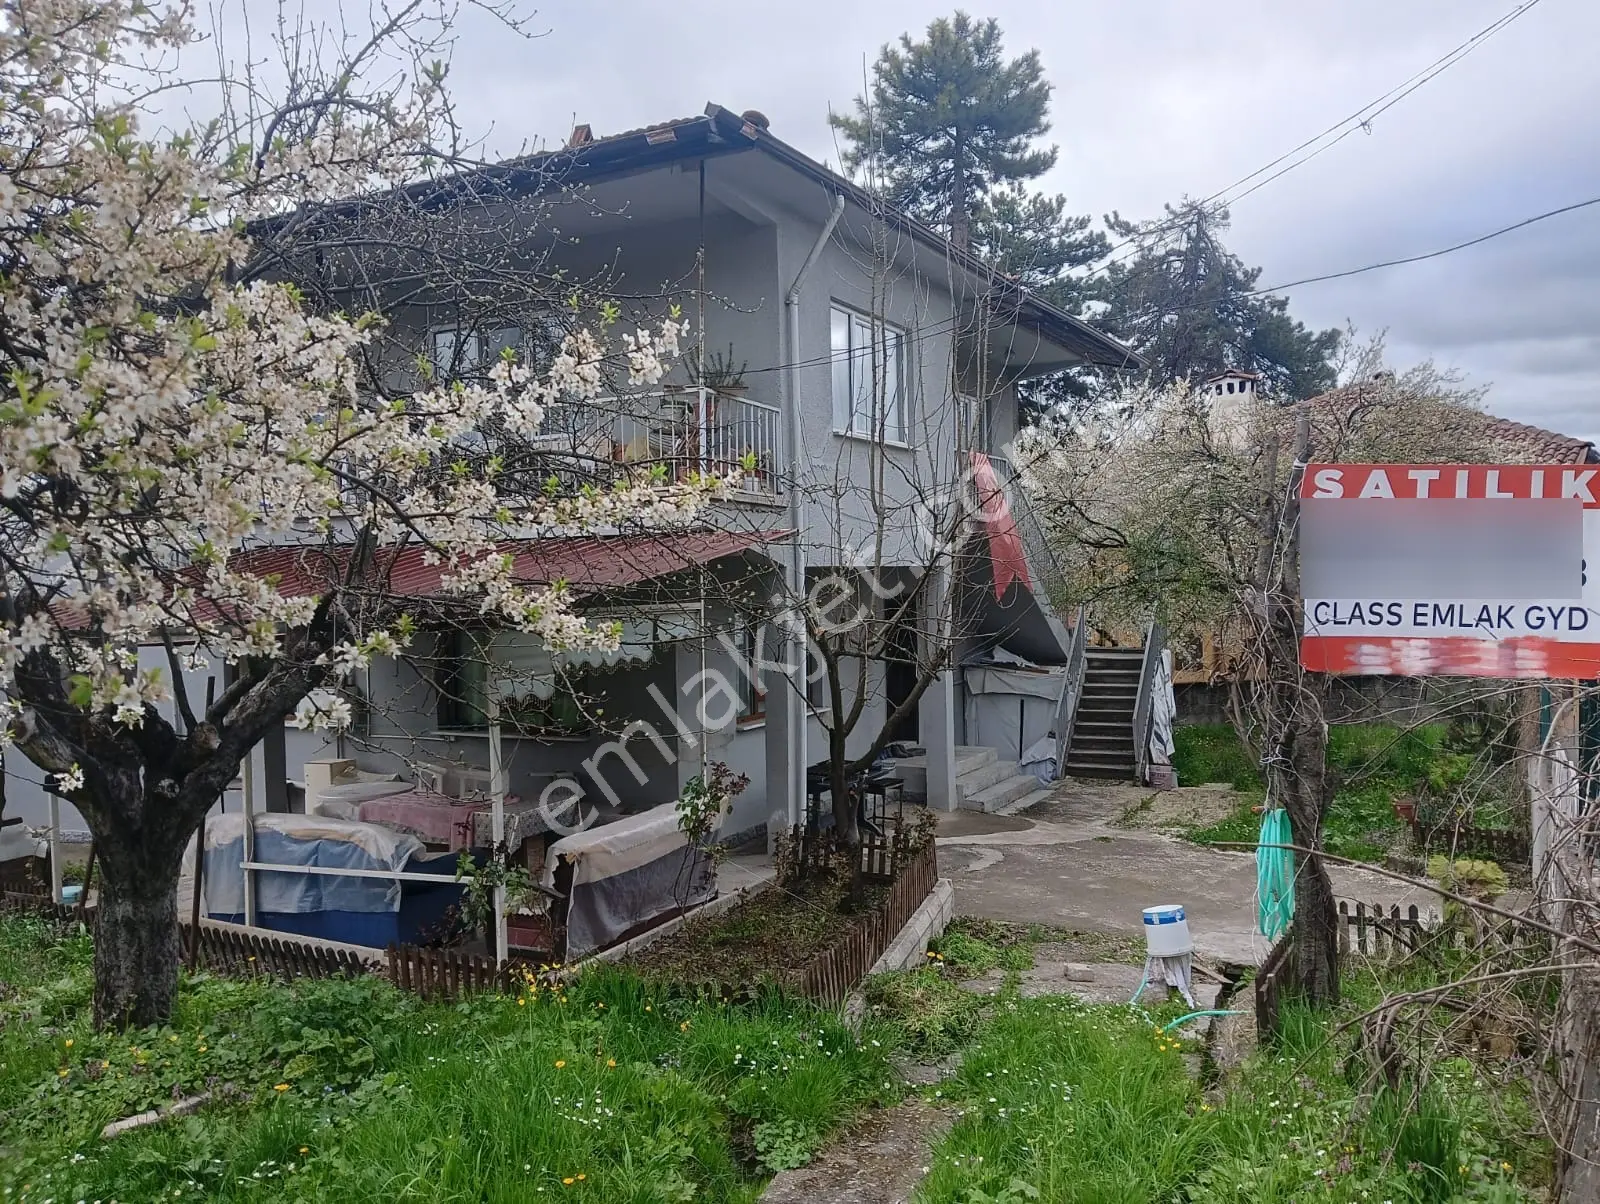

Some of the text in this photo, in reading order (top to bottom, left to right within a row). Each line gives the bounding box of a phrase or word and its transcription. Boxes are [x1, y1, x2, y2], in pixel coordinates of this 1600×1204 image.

[1312, 469, 1597, 502] SATILIK
[1313, 601, 1588, 631] CLASS EMLAK GYD
